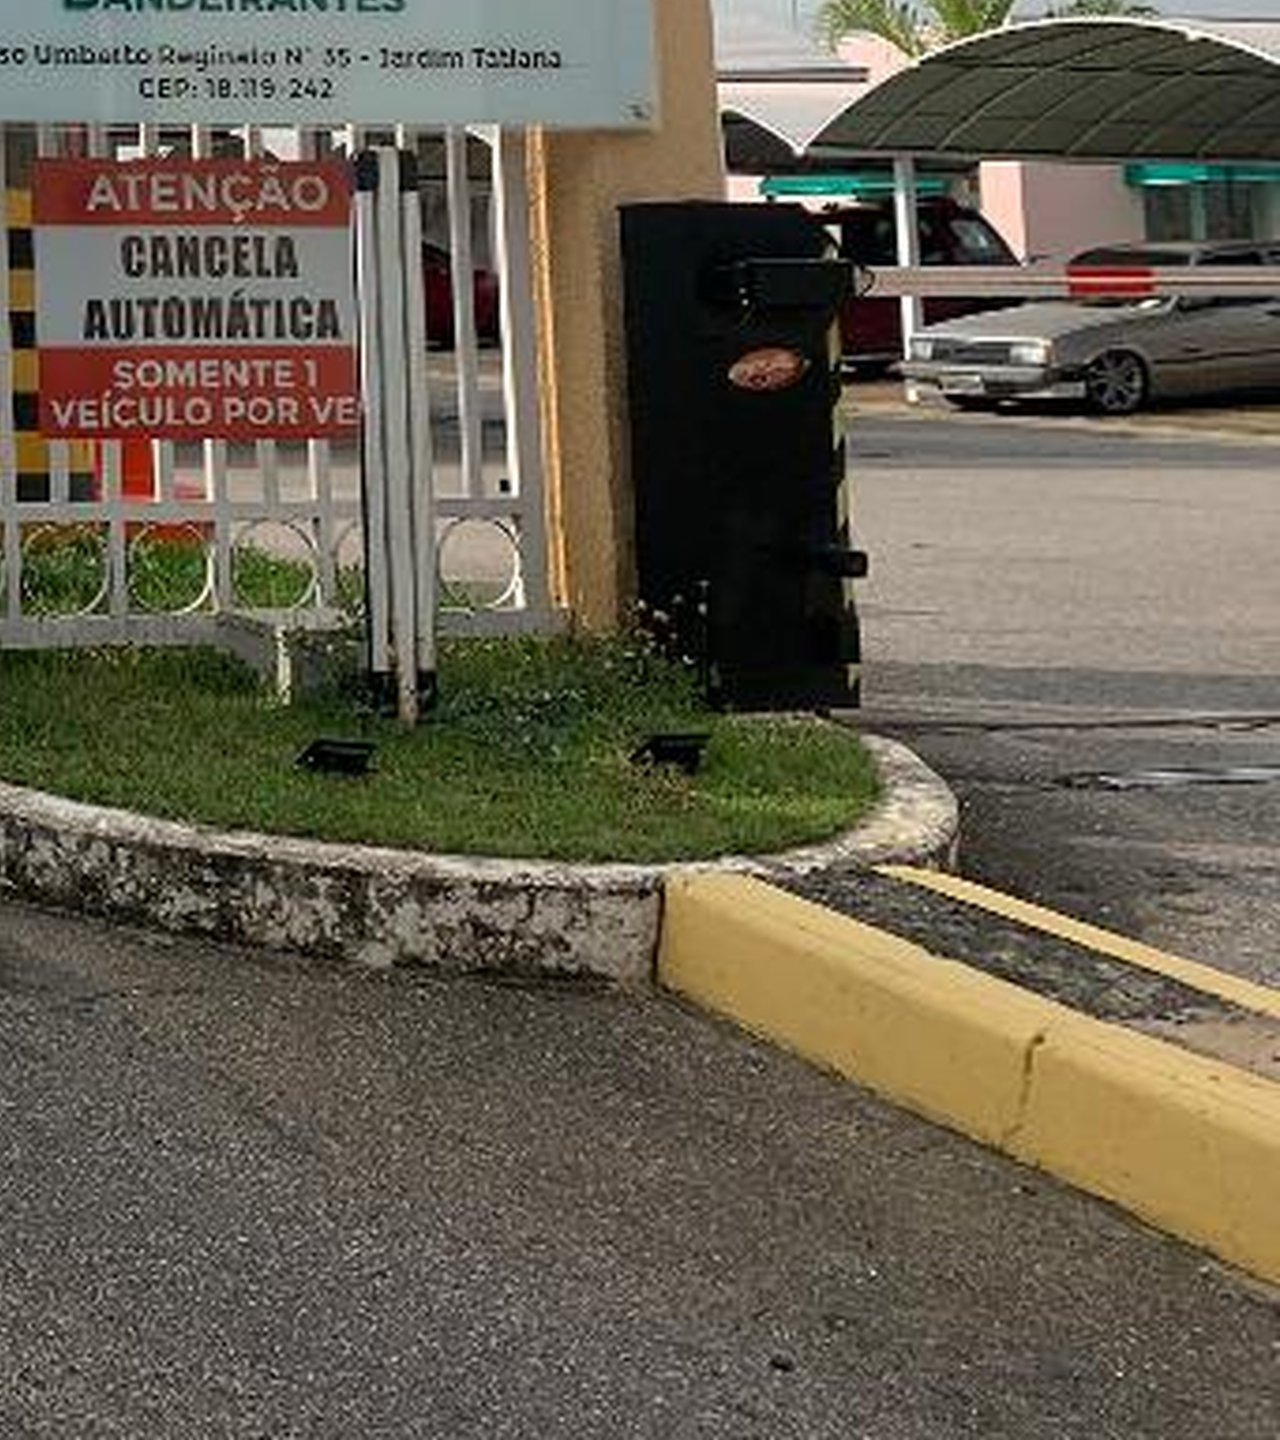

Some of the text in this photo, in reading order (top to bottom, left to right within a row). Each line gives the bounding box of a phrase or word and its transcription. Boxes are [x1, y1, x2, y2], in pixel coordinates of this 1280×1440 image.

[139, 77, 198, 99] CEP:
[88, 163, 329, 224] ATENÇÃO
[121, 235, 300, 279] CANCELA
[83, 291, 342, 340] AUTOMÁTICA
[113, 359, 295, 389] SOMENTE
[49, 389, 361, 429] VEÍCULO POR VE
